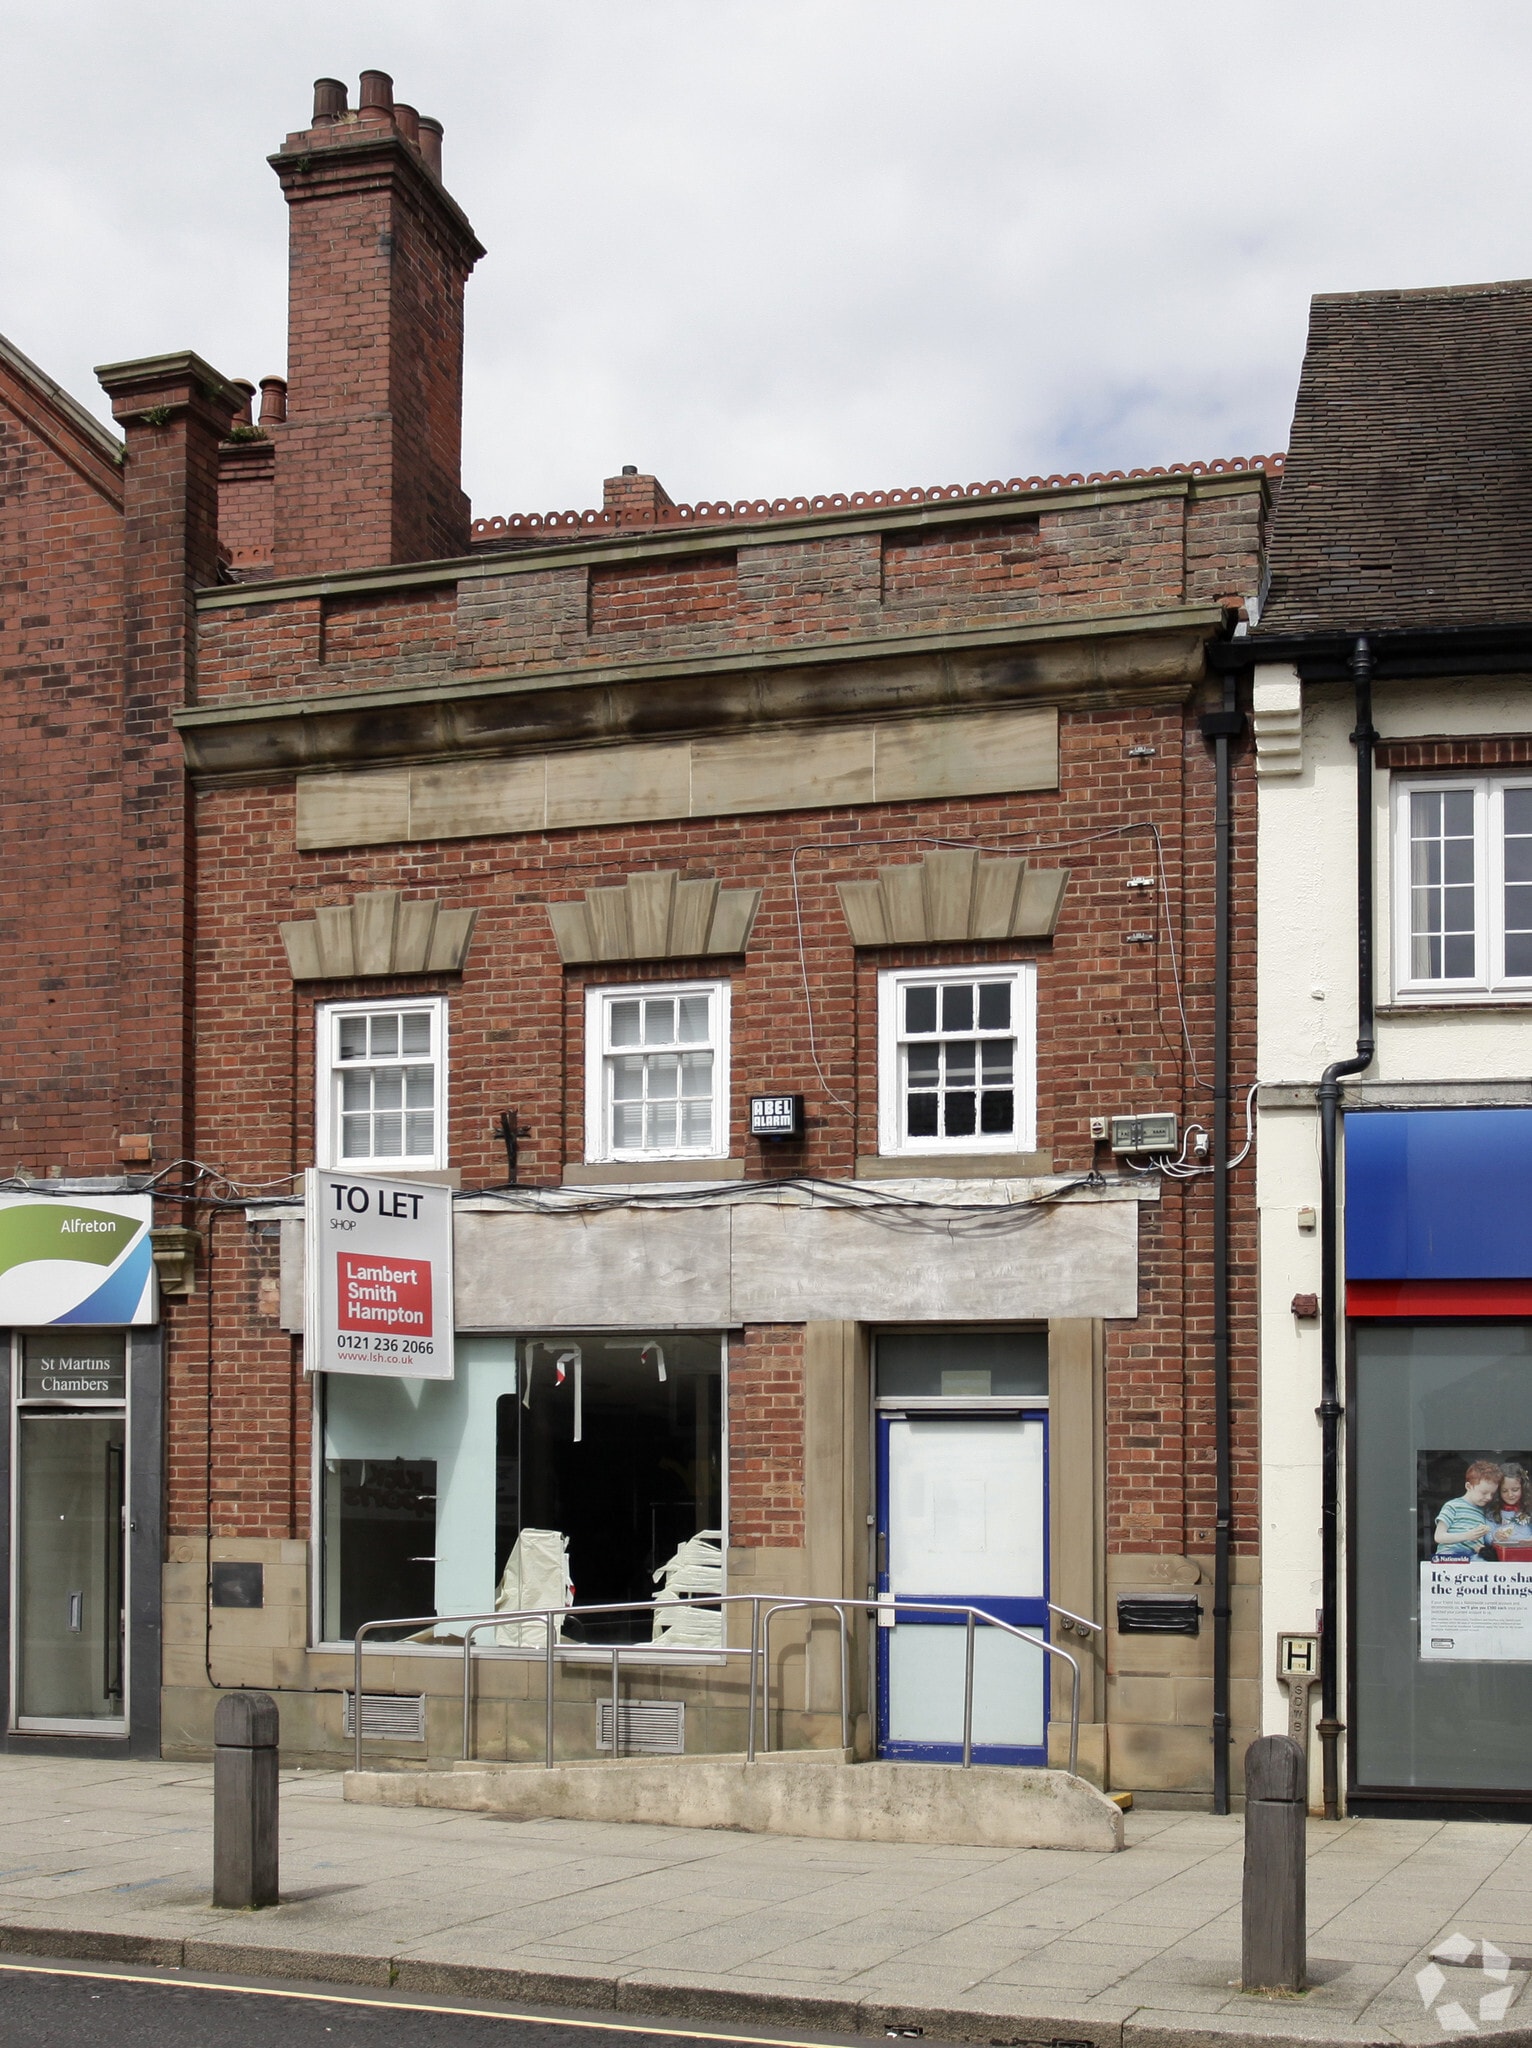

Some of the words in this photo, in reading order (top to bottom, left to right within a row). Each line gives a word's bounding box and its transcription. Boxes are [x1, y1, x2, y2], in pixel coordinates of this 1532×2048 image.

[754, 1100, 790, 1116] ABEL
[754, 1115, 791, 1127] ALARM
[330, 1183, 370, 1214] TO
[378, 1189, 424, 1220] LET
[60, 1218, 116, 1233] Alfreton
[329, 1218, 357, 1232] SHOP
[346, 1261, 418, 1286] Lambert
[347, 1282, 398, 1303] Smith
[347, 1301, 424, 1325] Hampton
[337, 1334, 369, 1350] 0121
[373, 1337, 399, 1352] 236
[402, 1339, 434, 1355] 2066
[41, 1357, 55, 1370] St
[59, 1358, 111, 1370] Martins
[337, 1352, 414, 1365] www.lsh.co.uk
[41, 1376, 109, 1391] Chambers
[1431, 1570, 1451, 1583] It's
[1454, 1573, 1489, 1585] great
[1493, 1574, 1507, 1583] to
[1431, 1584, 1453, 1595] the
[1456, 1584, 1488, 1597] good
[1492, 1585, 1532, 1598] things
[1287, 1641, 1312, 1671] H
